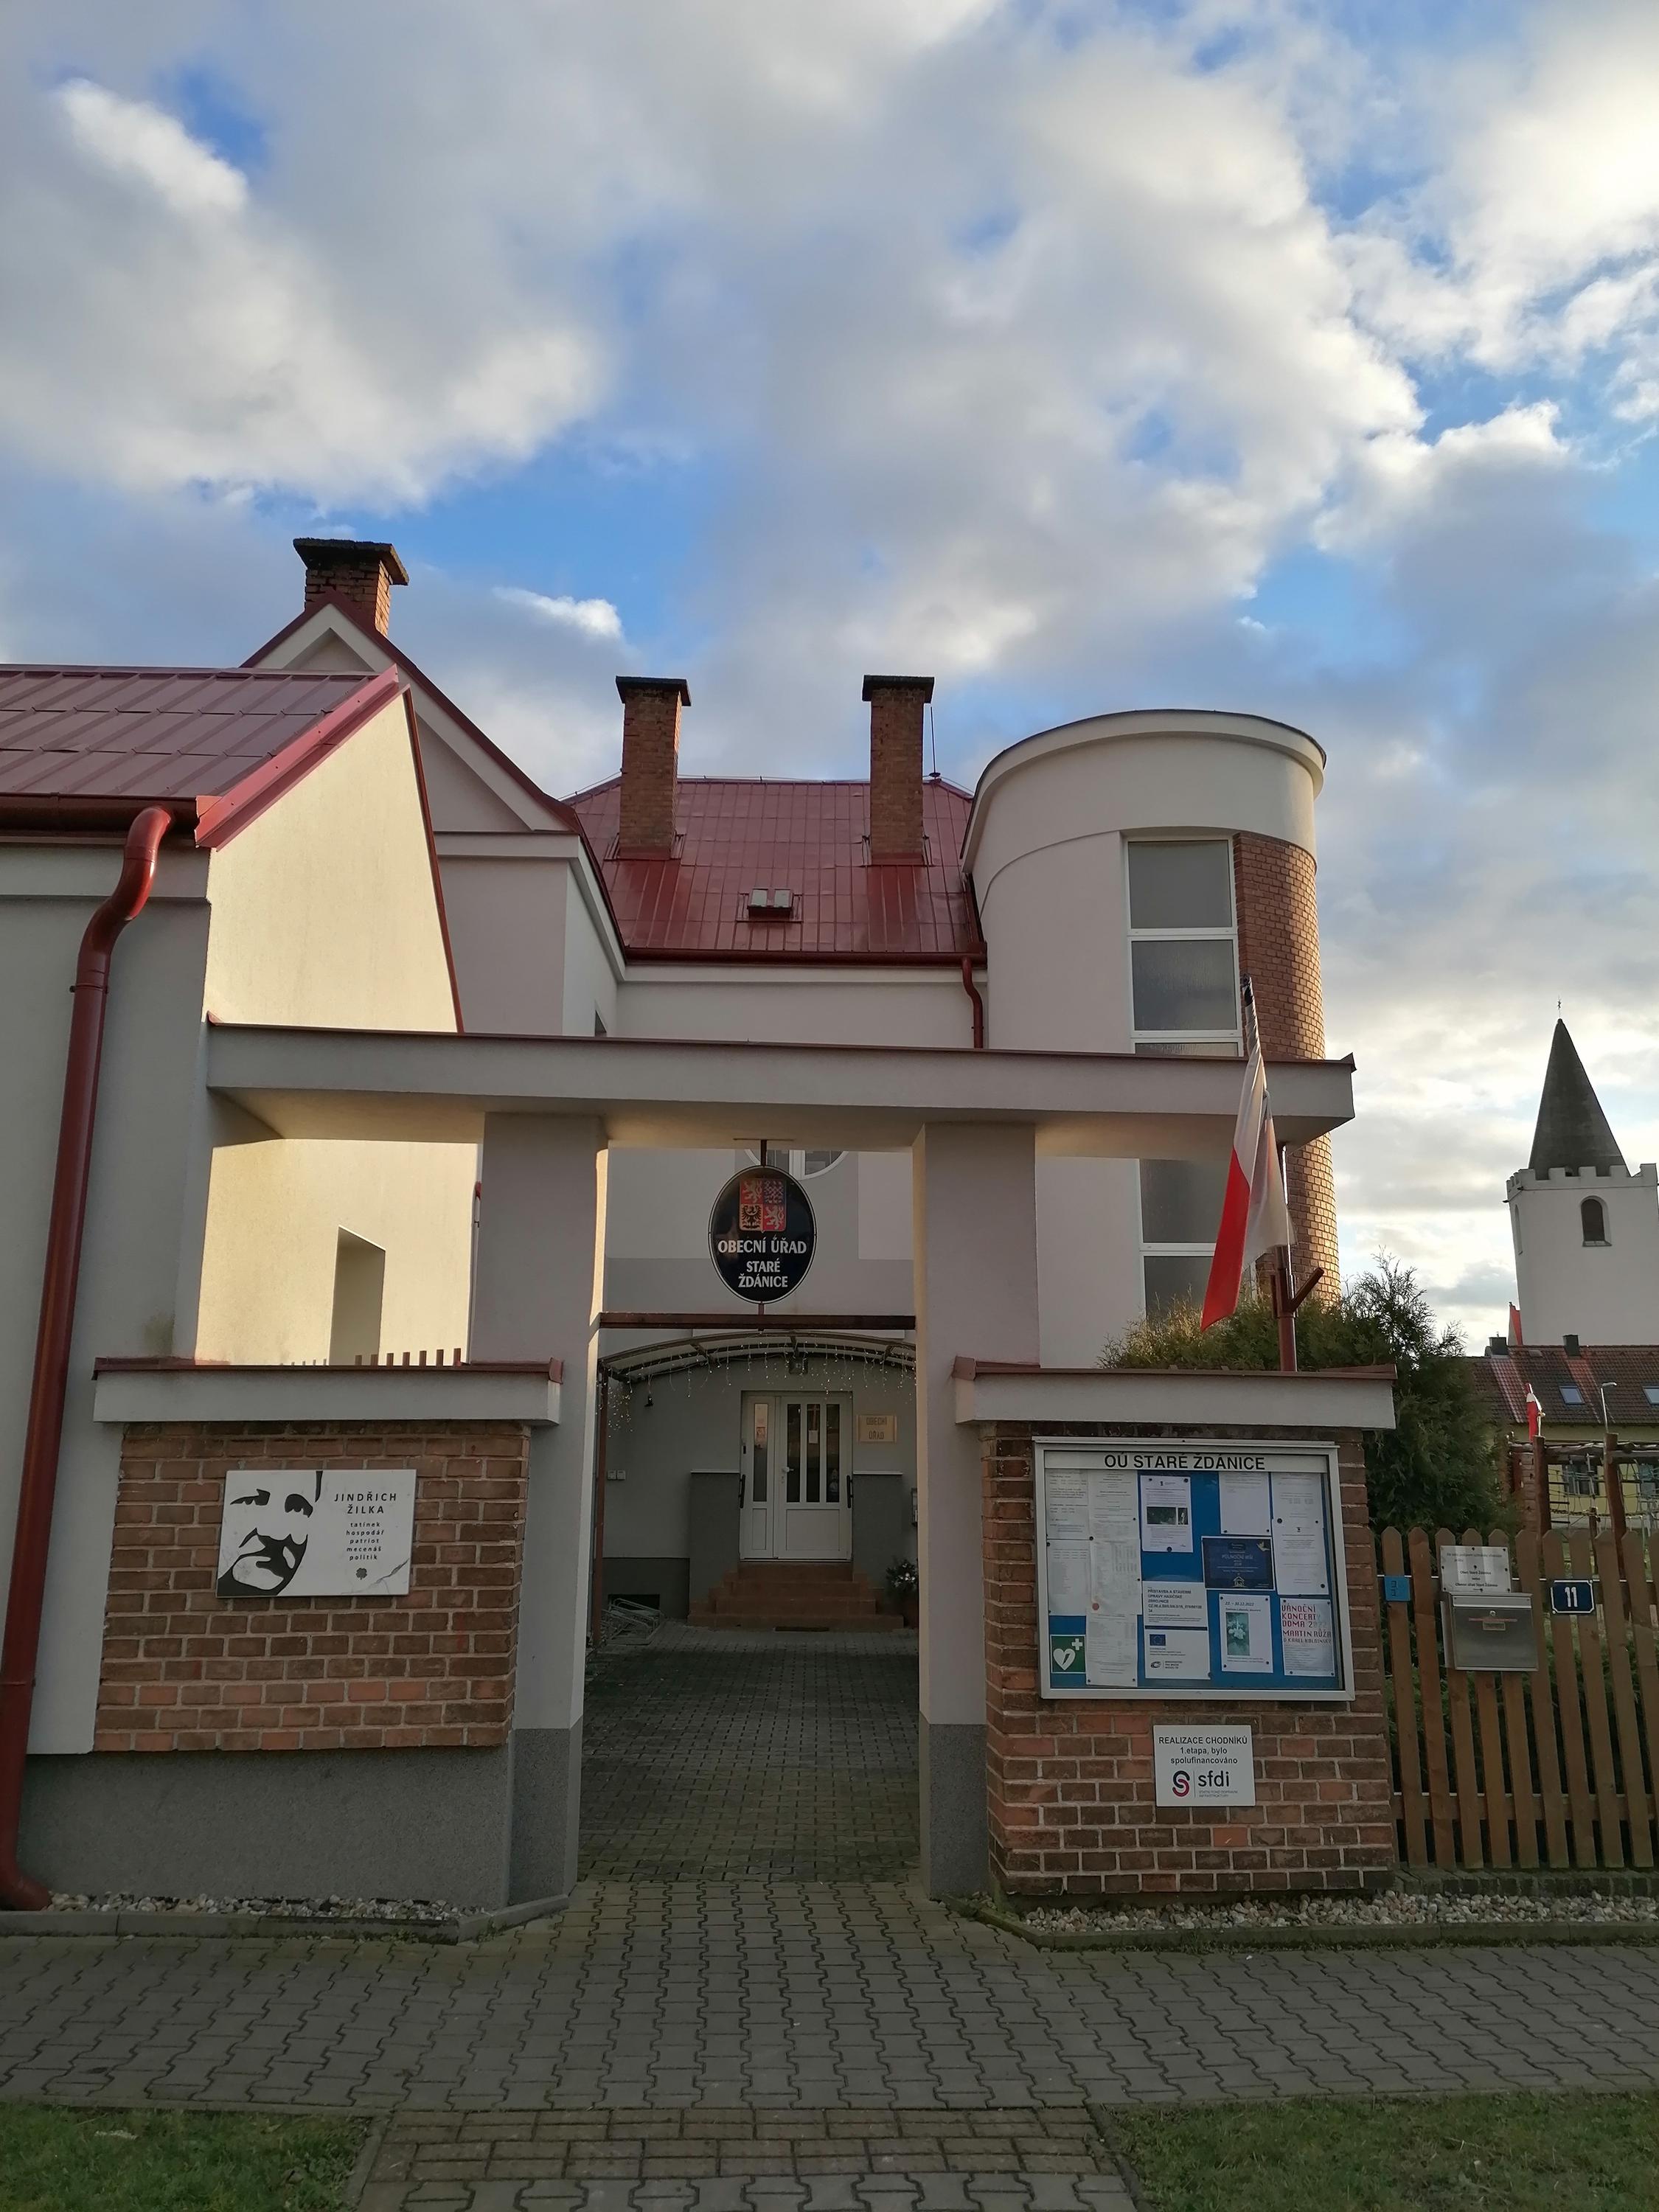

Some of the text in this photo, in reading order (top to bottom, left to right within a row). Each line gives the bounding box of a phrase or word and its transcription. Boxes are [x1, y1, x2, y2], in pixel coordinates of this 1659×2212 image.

[717, 1236, 807, 1253] OBECNÍ ÚŘAD
[746, 1258, 781, 1273] STARÉ
[738, 1273, 788, 1288] ŽDÁNICE
[1105, 1452, 1265, 1470] OÚ STARÉ ŽDÁNICE
[334, 1491, 397, 1502] JINDŘICH
[347, 1504, 384, 1514] ŽILKA
[1564, 1585, 1578, 1608] 11
[1281, 1603, 1315, 1613] VÁNOČNÍ
[1314, 1628, 1332, 1638] RŮŽA
[1206, 1735, 1248, 1744] CHODNÍKŮ
[1180, 1747, 1228, 1756] 1.etapa, bylo
[1170, 1756, 1238, 1765] spolufinancováno
[1197, 1770, 1230, 1787] sfdi
